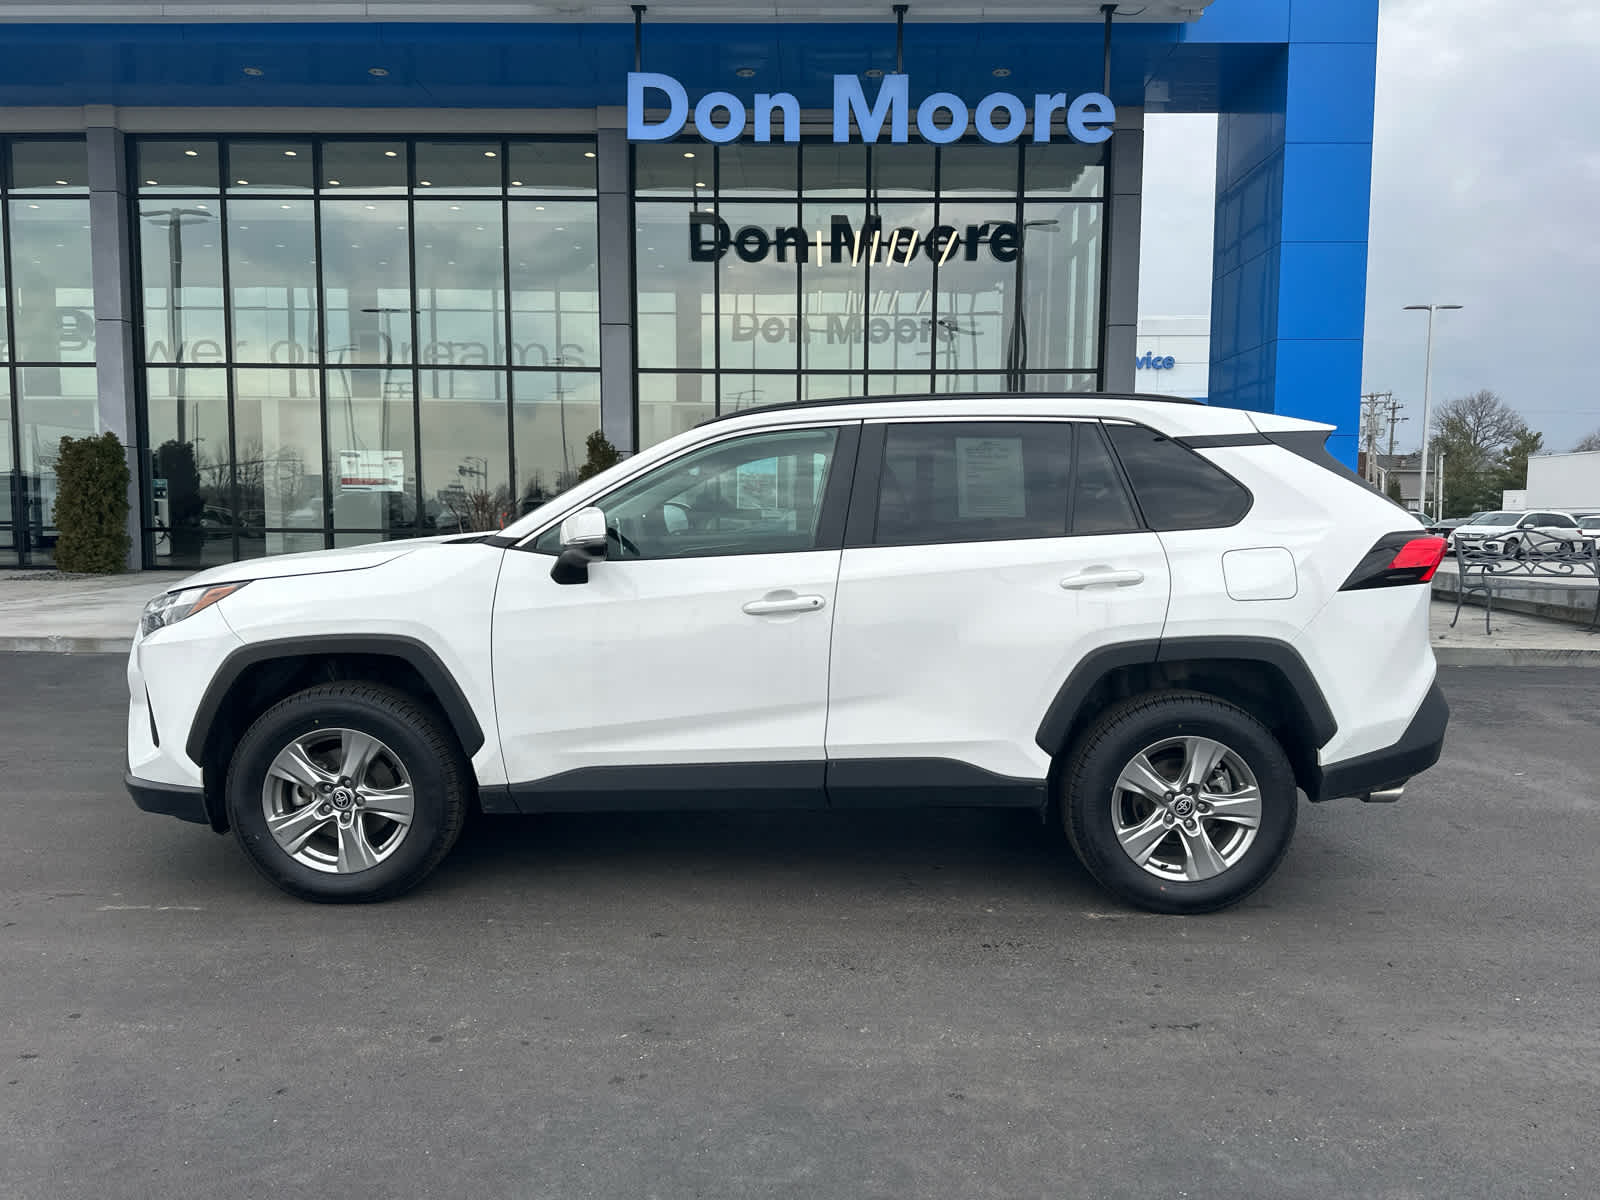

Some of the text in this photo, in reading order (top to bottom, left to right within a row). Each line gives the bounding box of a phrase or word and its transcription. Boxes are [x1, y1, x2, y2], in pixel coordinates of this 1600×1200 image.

[626, 71, 1117, 144] Don Moore
[688, 211, 1019, 263] Don Moore
[731, 313, 811, 343] Don
[1135, 351, 1176, 370] vice
